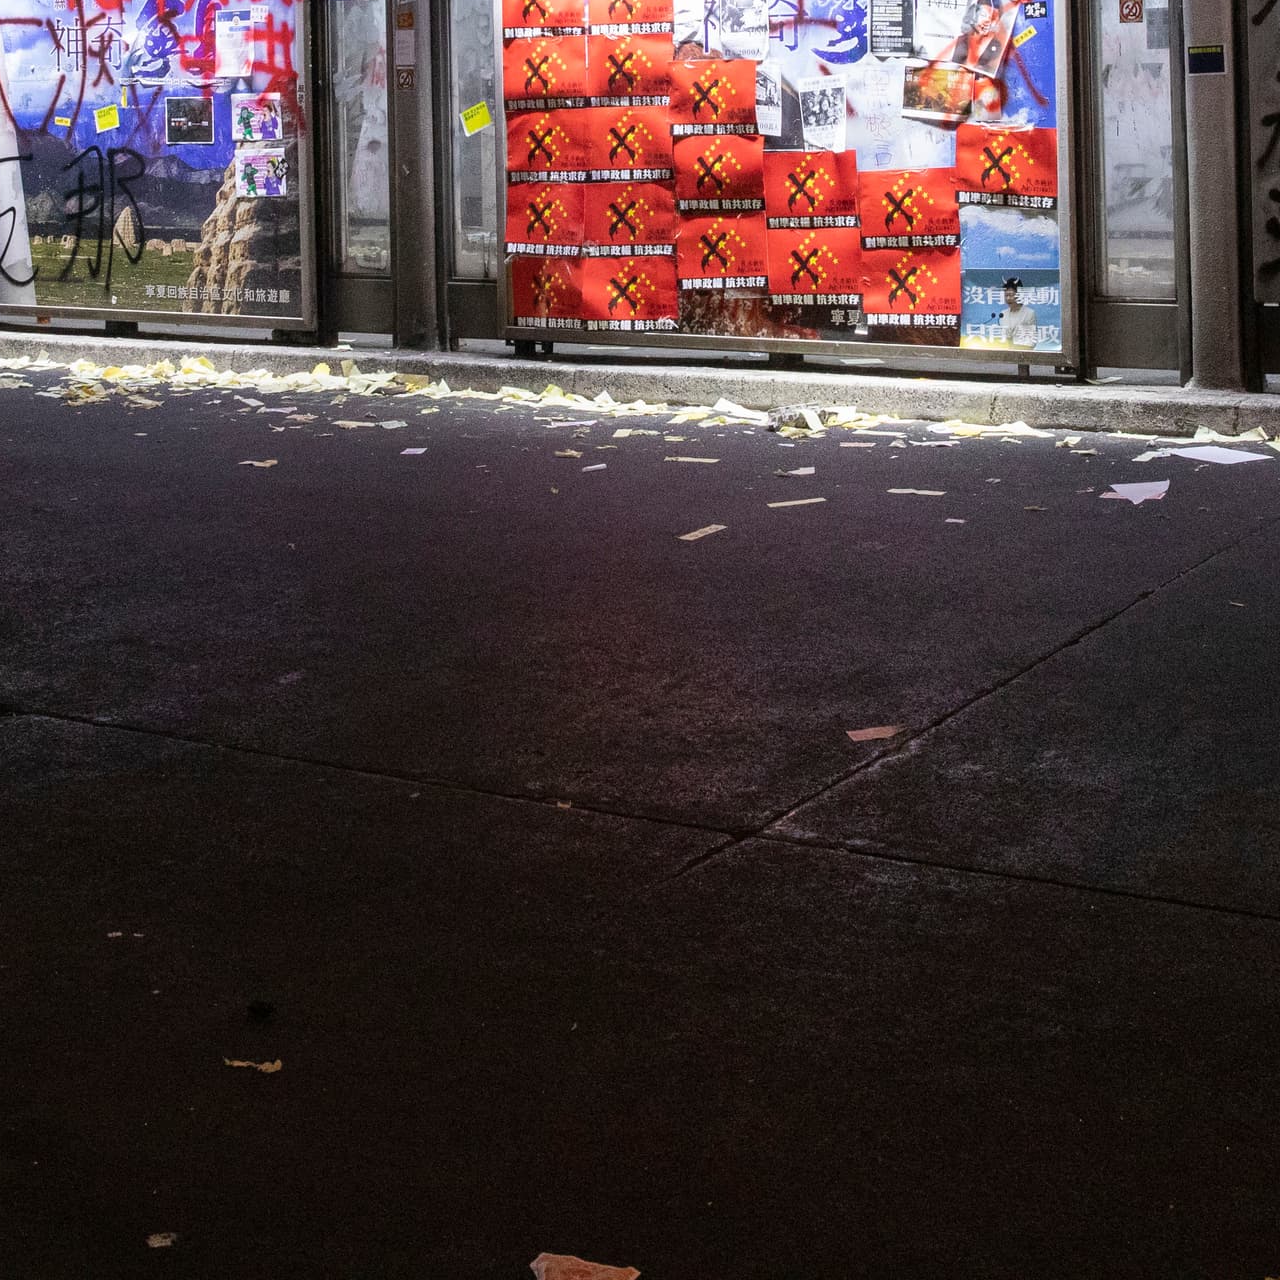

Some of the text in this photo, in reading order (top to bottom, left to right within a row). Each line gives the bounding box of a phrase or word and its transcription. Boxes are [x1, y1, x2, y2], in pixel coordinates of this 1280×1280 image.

[144, 285, 291, 305] 寧夏回族自治區文化和旅遊廳
[964, 286, 1060, 306] 沒有暴動
[966, 324, 1060, 343] 只有暴政
